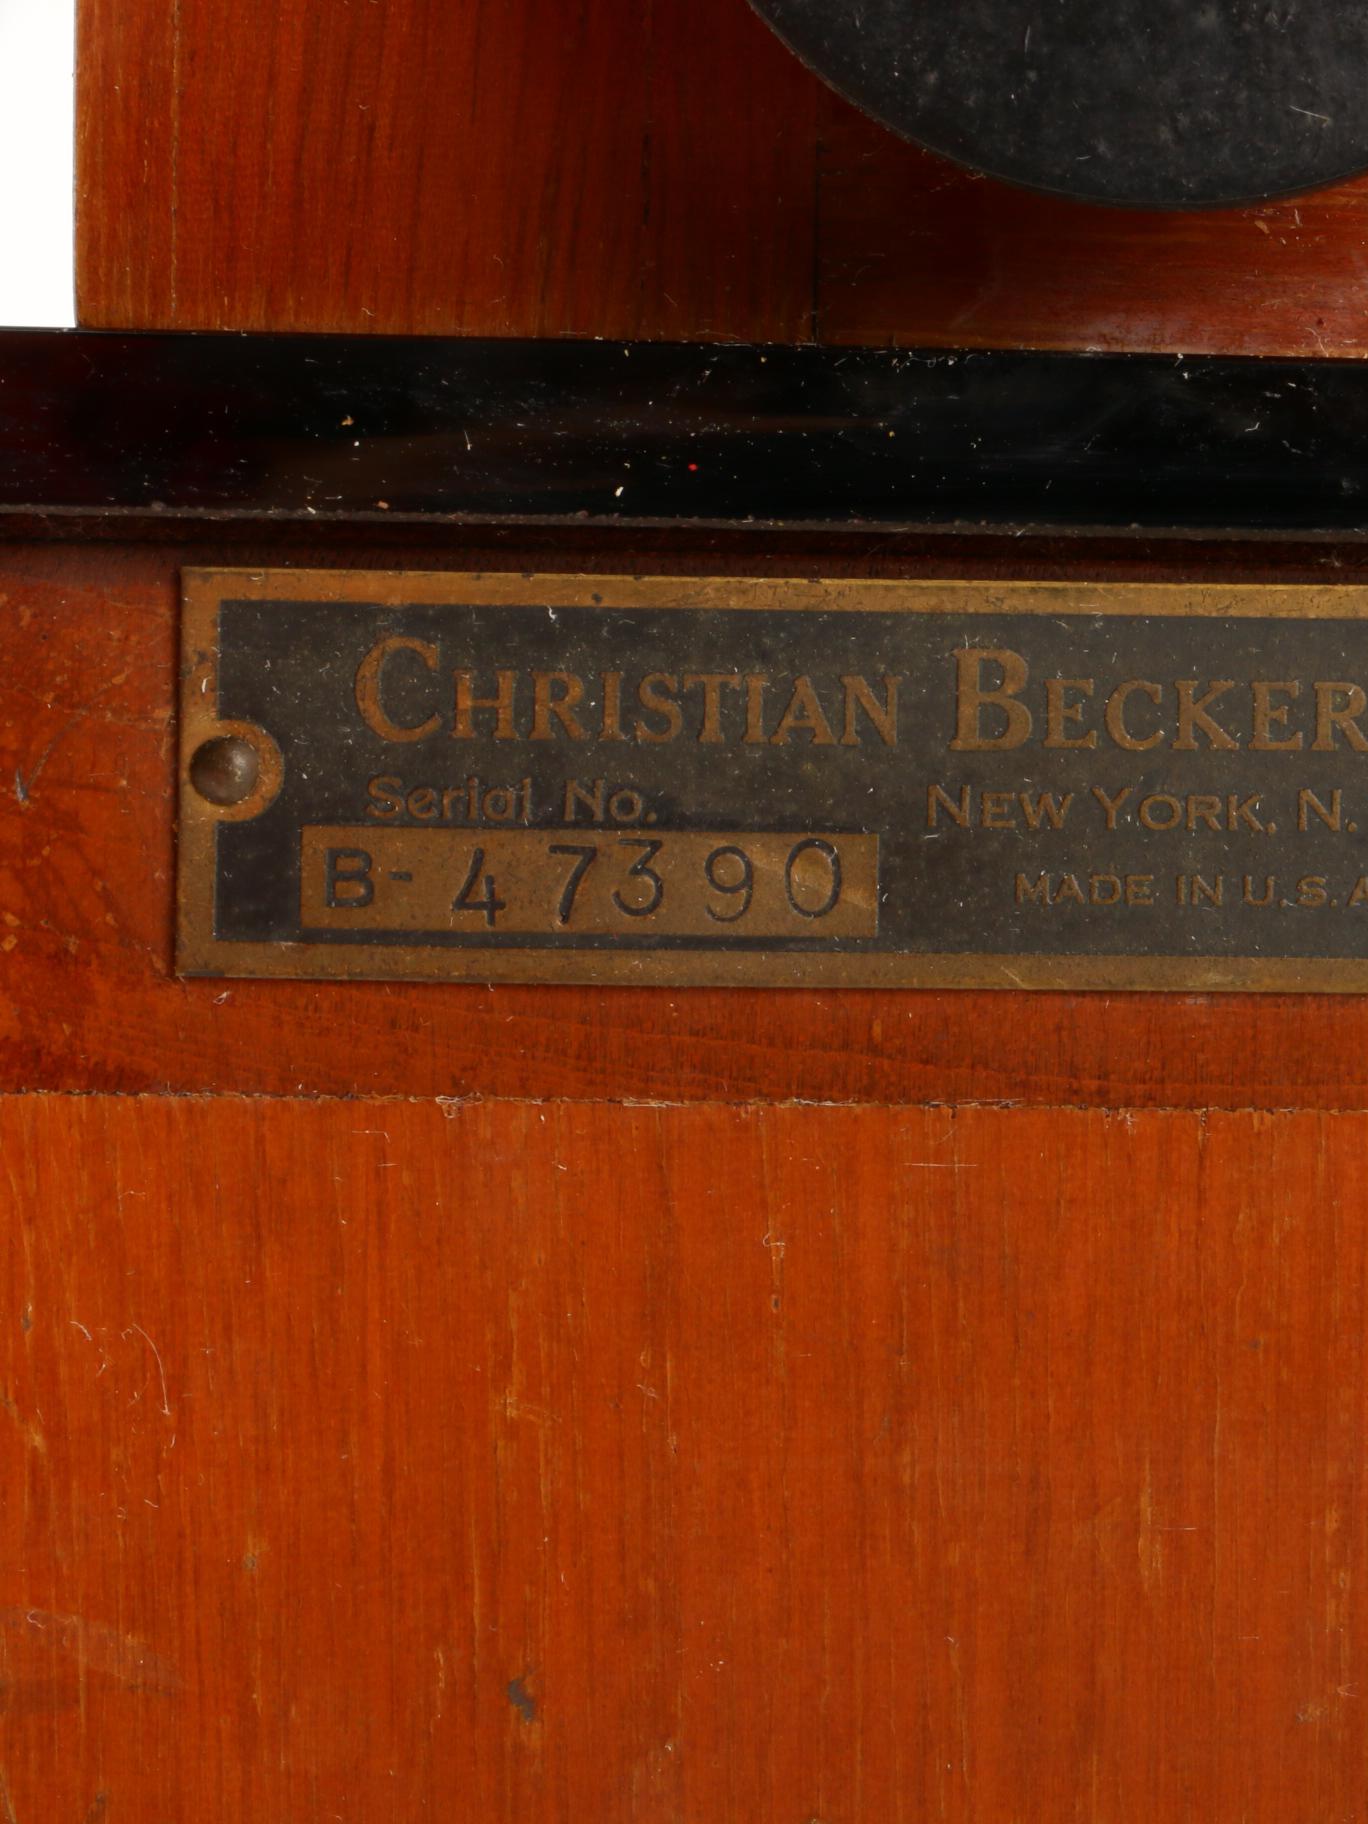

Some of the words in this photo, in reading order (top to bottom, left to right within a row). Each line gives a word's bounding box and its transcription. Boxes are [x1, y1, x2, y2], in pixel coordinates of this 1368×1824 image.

[354, 635, 900, 747] CHRISTIAN
[365, 774, 532, 824] Serial
[561, 779, 659, 824] No.
[926, 784, 1075, 831] NEW
[1015, 873, 1154, 906] MADE
[1175, 875, 1224, 906] IN
